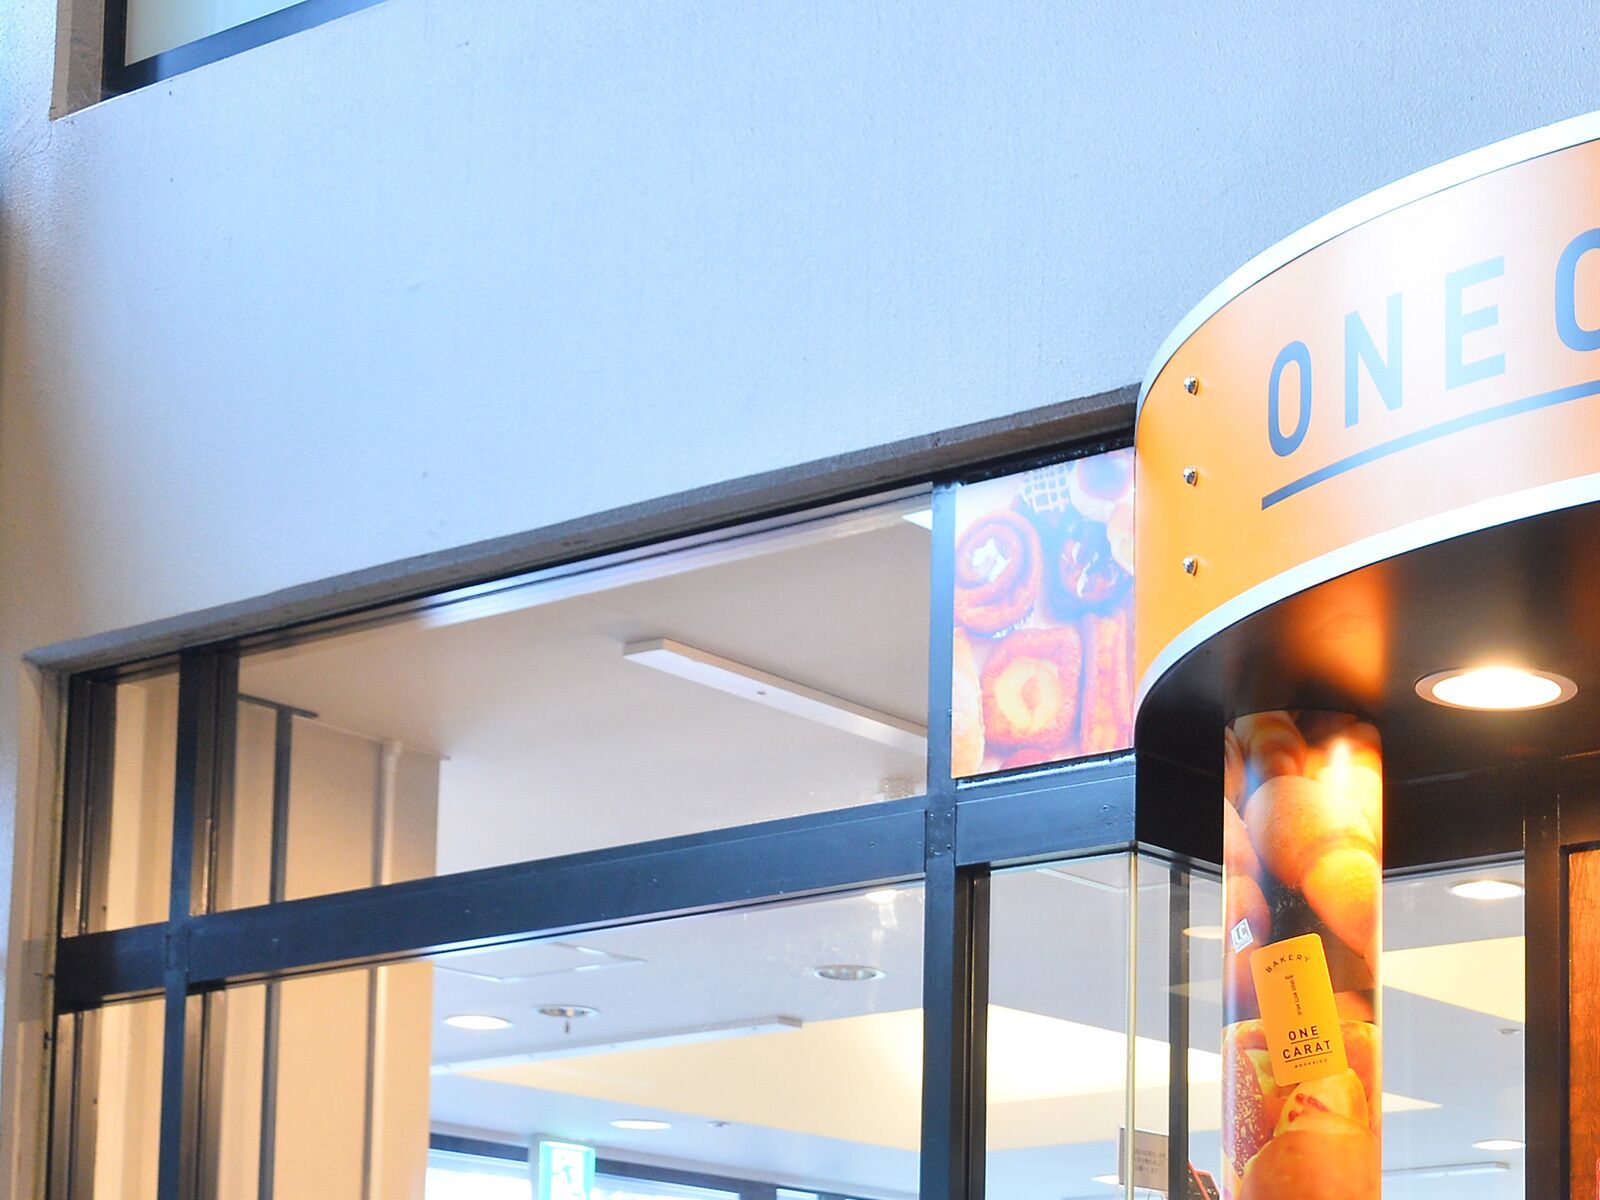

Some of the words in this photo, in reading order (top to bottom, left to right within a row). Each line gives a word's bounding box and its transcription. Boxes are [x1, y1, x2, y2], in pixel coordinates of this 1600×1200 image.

[1265, 954, 1310, 973] BAKERY
[1288, 1025, 1319, 1041] ONE
[1282, 1040, 1331, 1059] CARAT
